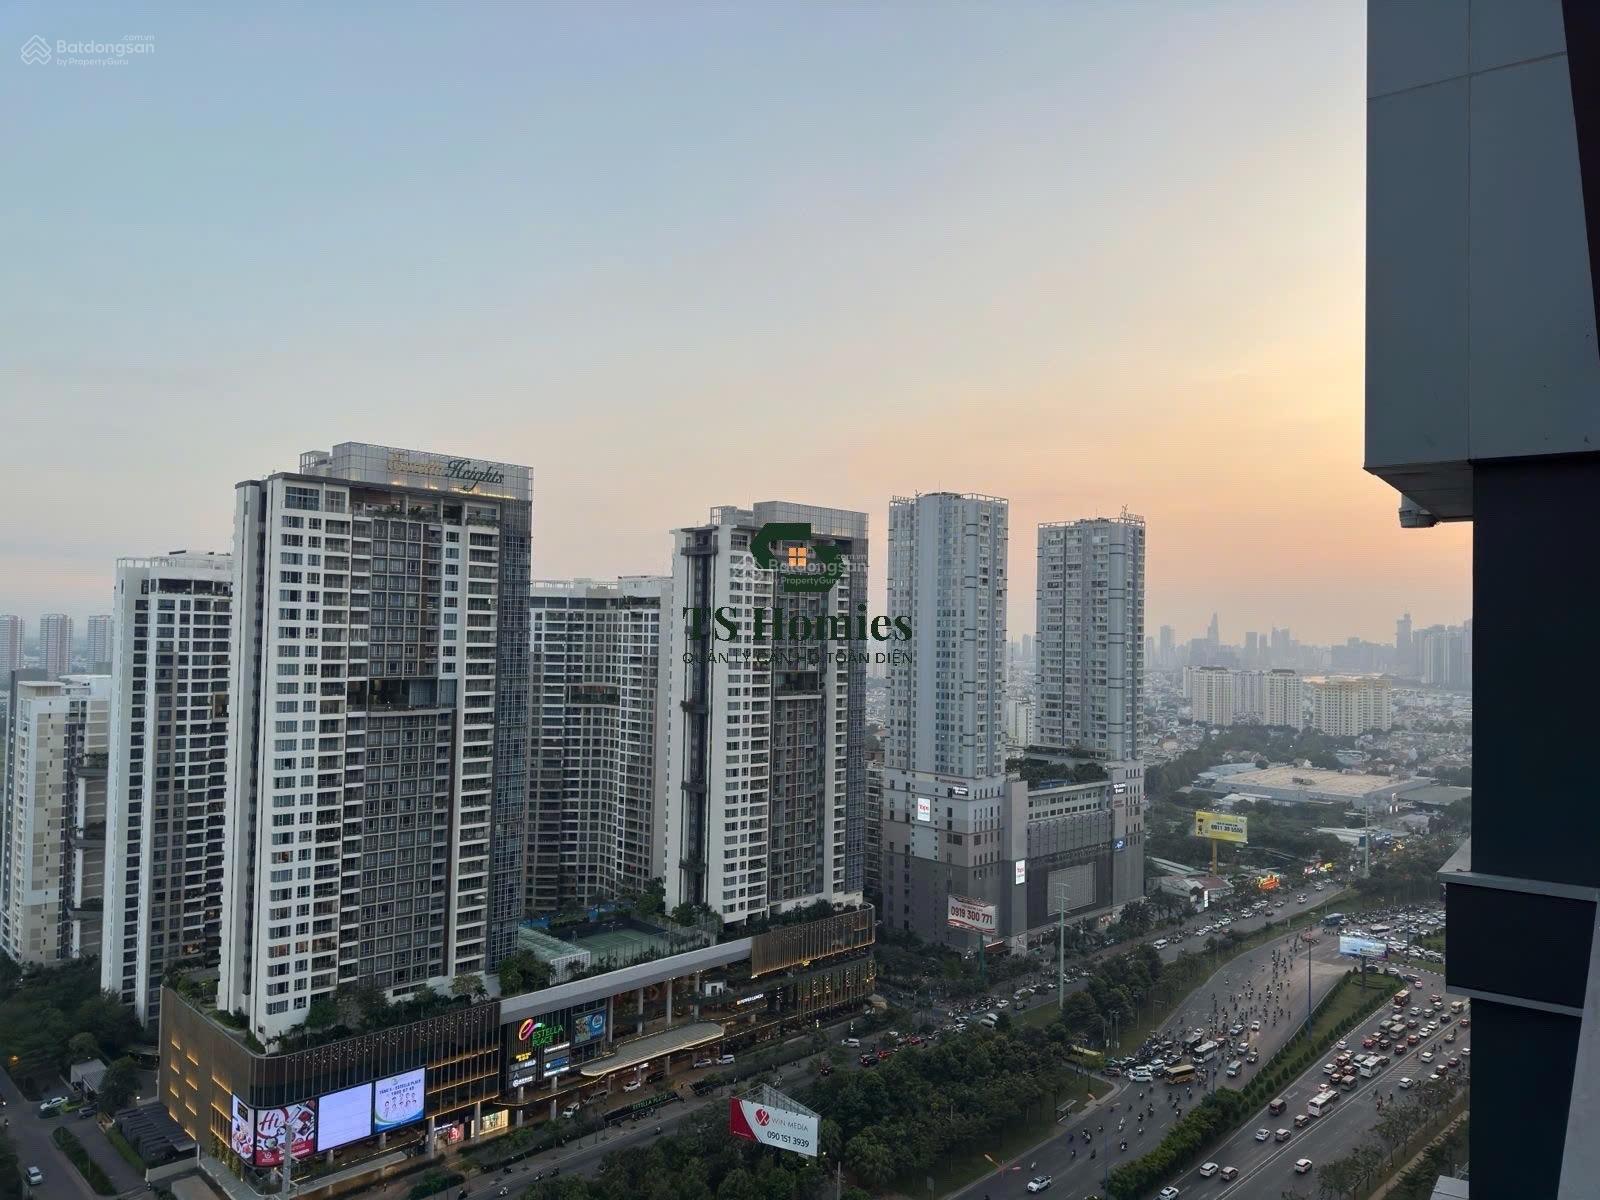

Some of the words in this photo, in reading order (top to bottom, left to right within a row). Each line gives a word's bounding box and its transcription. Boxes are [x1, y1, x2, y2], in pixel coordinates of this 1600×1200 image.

[445, 459, 504, 491] Heights
[950, 906, 966, 918] 0919
[966, 909, 980, 921] 300
[981, 913, 993, 924] 771
[532, 1024, 564, 1039] ESTELLA
[771, 1117, 786, 1126] WIN
[787, 1121, 808, 1132] MEDIA
[767, 1130, 780, 1141] 090
[780, 1133, 791, 1144] 151
[792, 1137, 810, 1148] 3939
